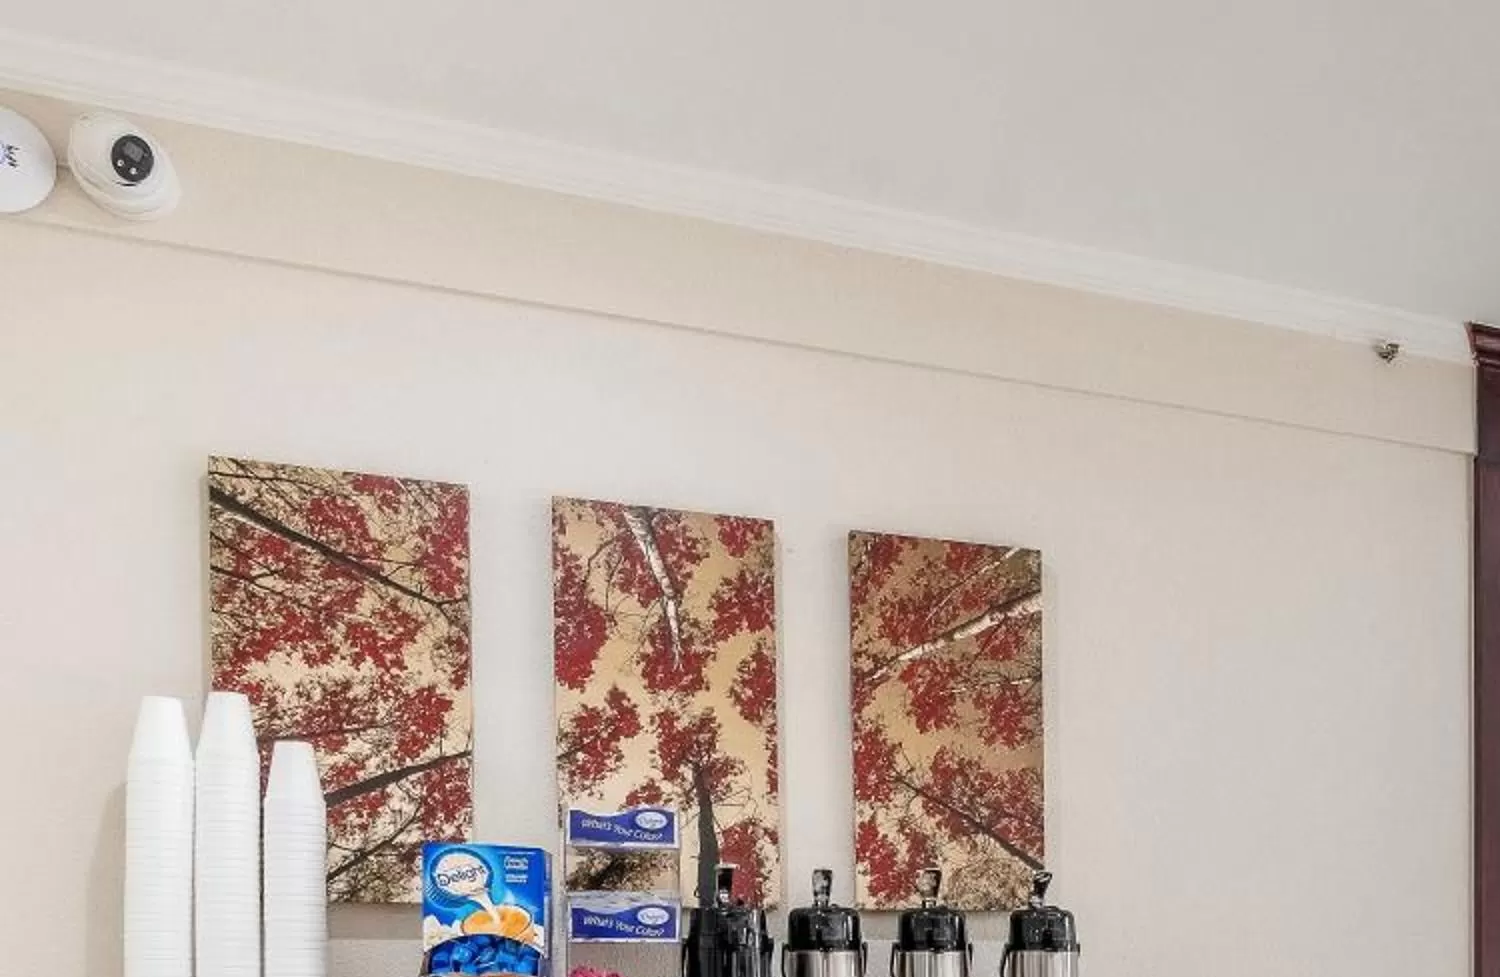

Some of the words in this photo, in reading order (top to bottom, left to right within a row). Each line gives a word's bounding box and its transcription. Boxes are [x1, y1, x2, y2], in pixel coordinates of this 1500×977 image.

[614, 824, 633, 837] Your
[437, 864, 486, 886] Delight
[616, 921, 634, 932] Your
